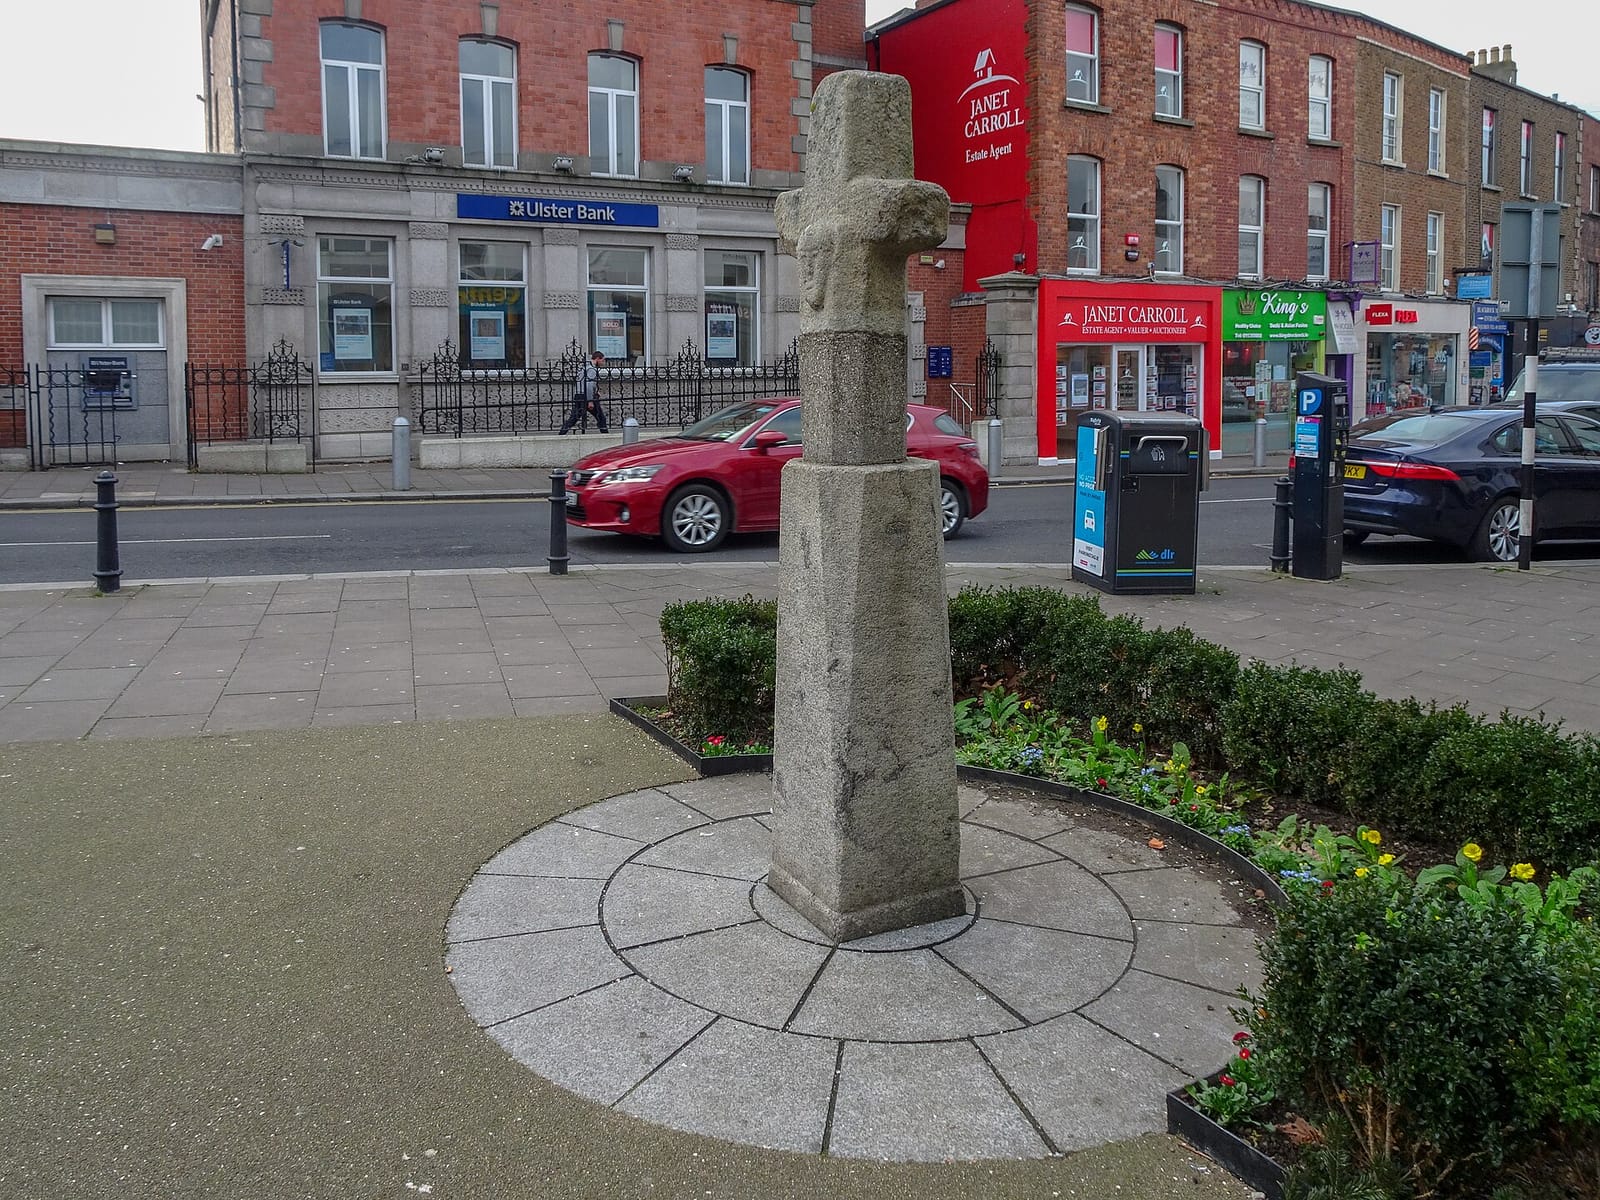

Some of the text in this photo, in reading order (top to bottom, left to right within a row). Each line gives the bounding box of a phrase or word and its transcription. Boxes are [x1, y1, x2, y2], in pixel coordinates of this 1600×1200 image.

[970, 89, 1010, 120] JANET
[964, 108, 1025, 138] CARROLL
[965, 142, 1012, 163] Estate Agent
[526, 201, 616, 221] Ulster Bank
[1082, 306, 1188, 326] JANET CARROLL
[1260, 292, 1309, 322] King's
[1303, 391, 1316, 411] P
[1160, 548, 1175, 560] dlr
